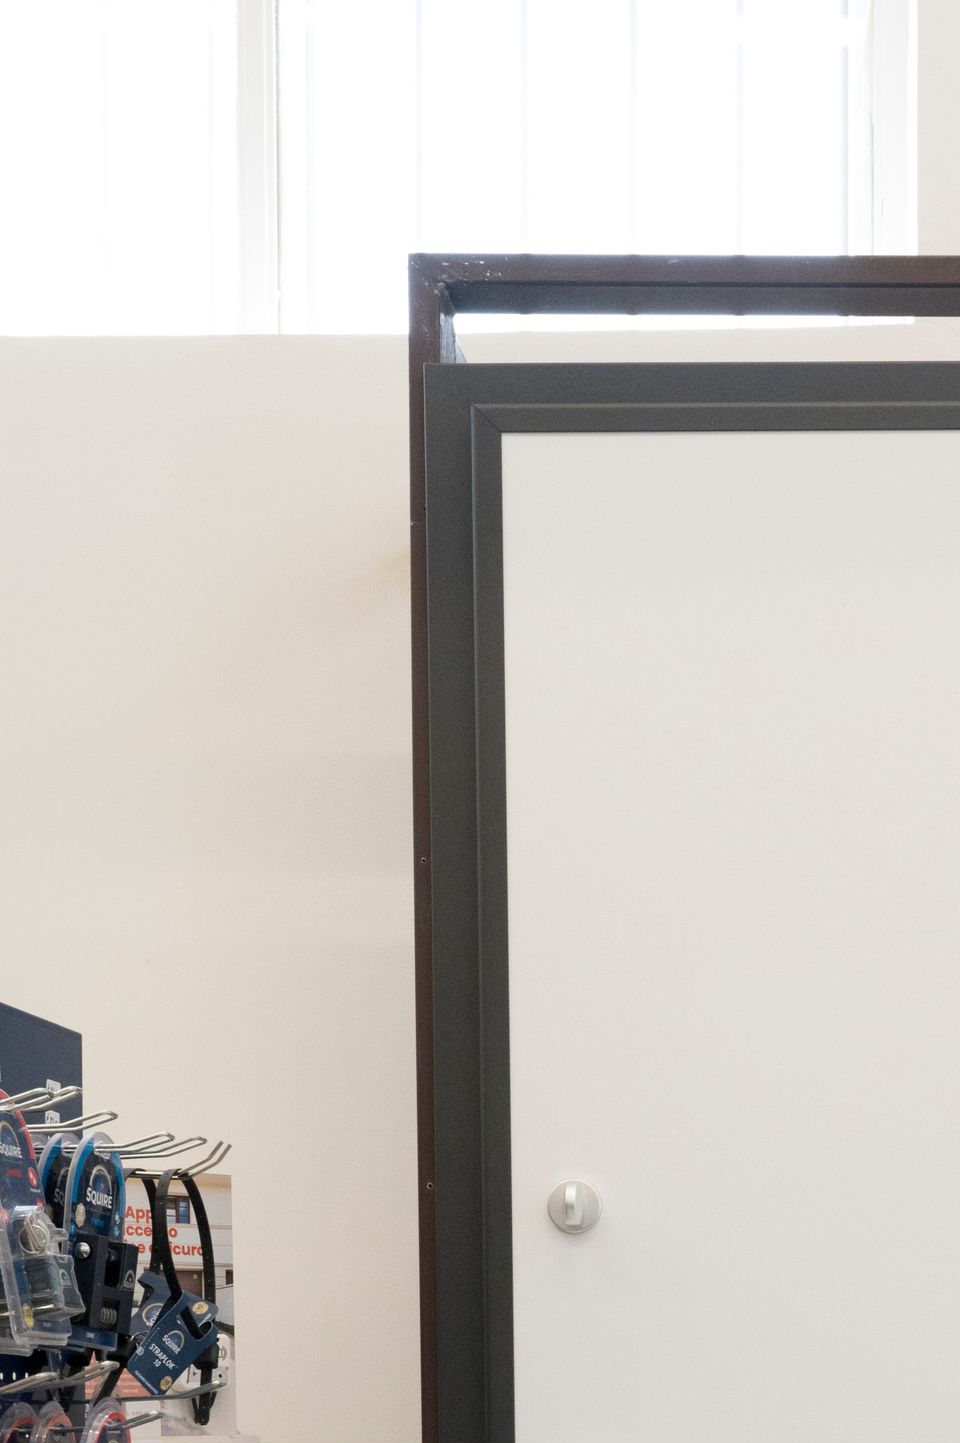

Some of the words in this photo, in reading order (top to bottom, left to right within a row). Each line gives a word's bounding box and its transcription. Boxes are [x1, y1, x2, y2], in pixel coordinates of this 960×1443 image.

[86, 1188, 112, 1208] SQUIRE
[125, 1226, 177, 1238] cceo
[162, 1334, 181, 1355] SQUIRE
[148, 1343, 176, 1370] STRAPLOK
[153, 1359, 162, 1368] 10
